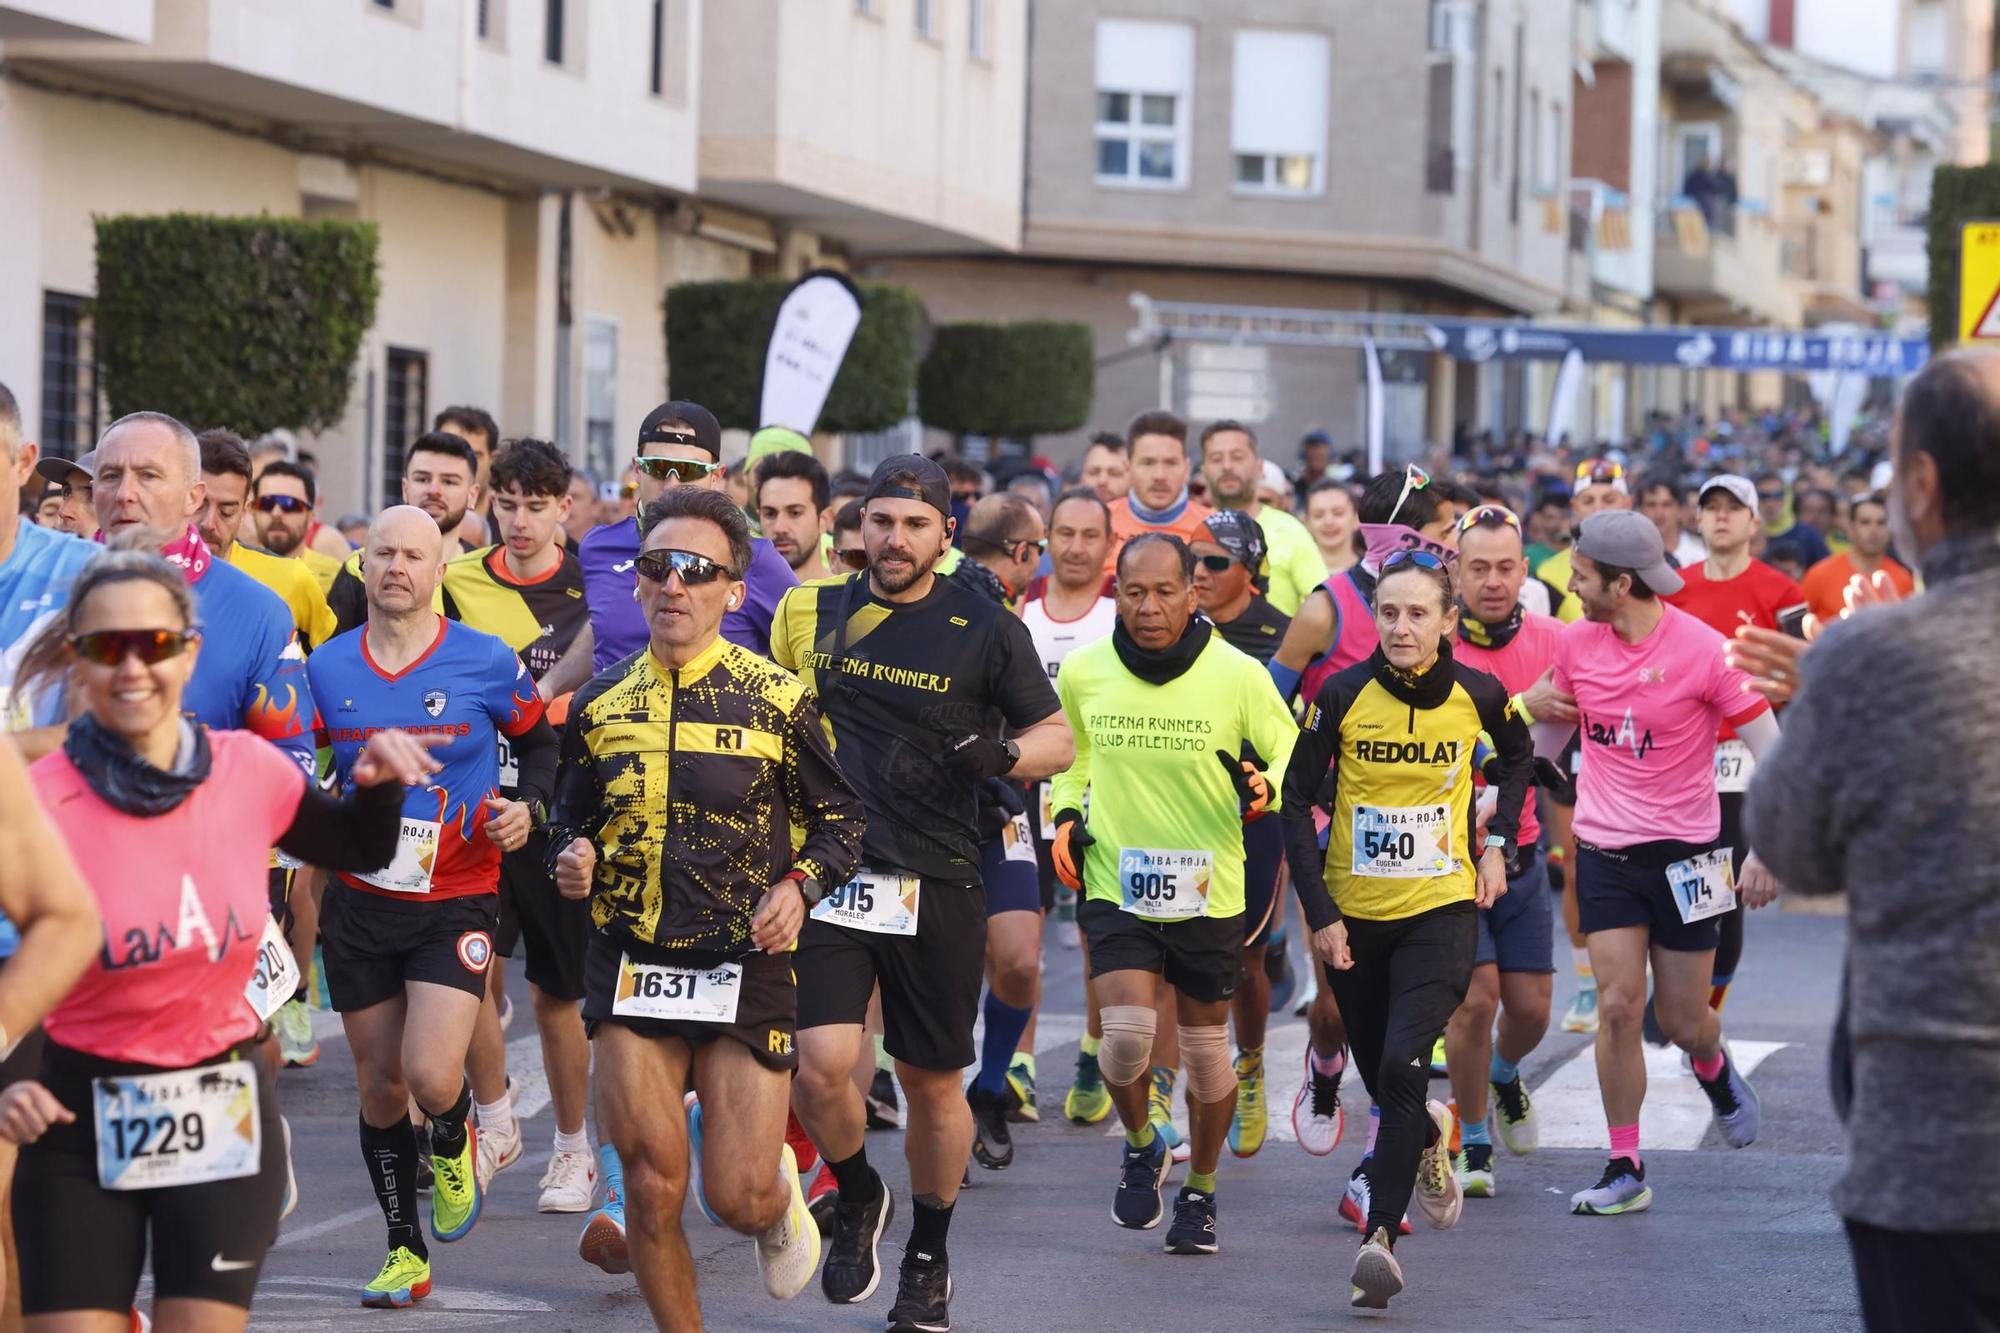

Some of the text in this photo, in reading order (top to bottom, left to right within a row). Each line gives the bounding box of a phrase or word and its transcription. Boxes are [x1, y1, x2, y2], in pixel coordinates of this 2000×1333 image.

[530, 648, 561, 660] RIBA-
[872, 663, 951, 693] RUNNERS
[1090, 715, 1212, 734] PATERNA RUNNERS
[1094, 733, 1206, 752] CLUB ATLETISMO
[1356, 740, 1458, 764] REDOLAT
[1377, 812, 1445, 825] RIBA-ROJA
[402, 825, 433, 839] ROJA
[1364, 831, 1415, 860] 540
[1143, 855, 1207, 867] RIBA-ROJA
[1376, 859, 1402, 867] EUGENIA
[1130, 872, 1177, 901] 905
[1682, 876, 1712, 906] 174
[828, 882, 875, 913] 915
[834, 908, 865, 920] MORALES
[632, 971, 697, 999] 1631
[109, 1111, 204, 1161] 1229
